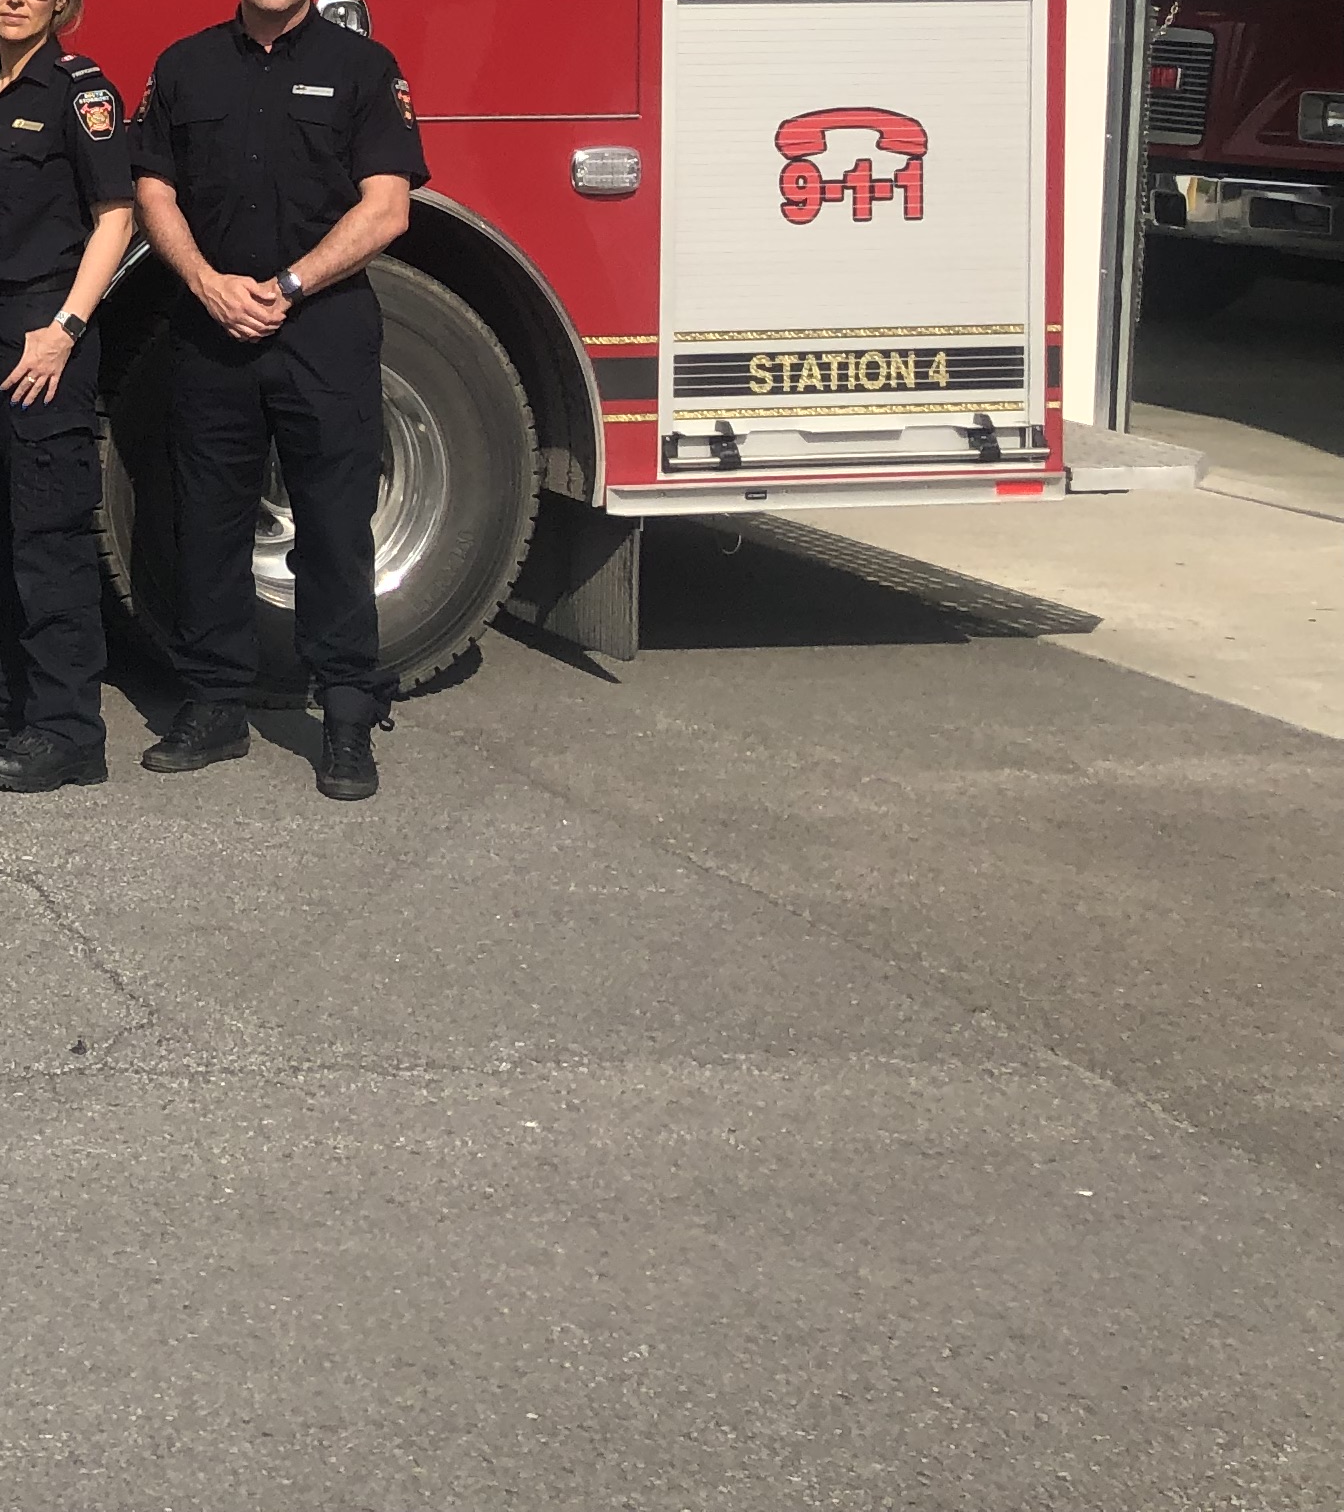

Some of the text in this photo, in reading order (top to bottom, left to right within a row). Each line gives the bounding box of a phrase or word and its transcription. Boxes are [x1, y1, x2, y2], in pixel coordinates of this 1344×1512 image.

[779, 157, 925, 225] 9-1-1
[749, 350, 950, 392] STATION 4
